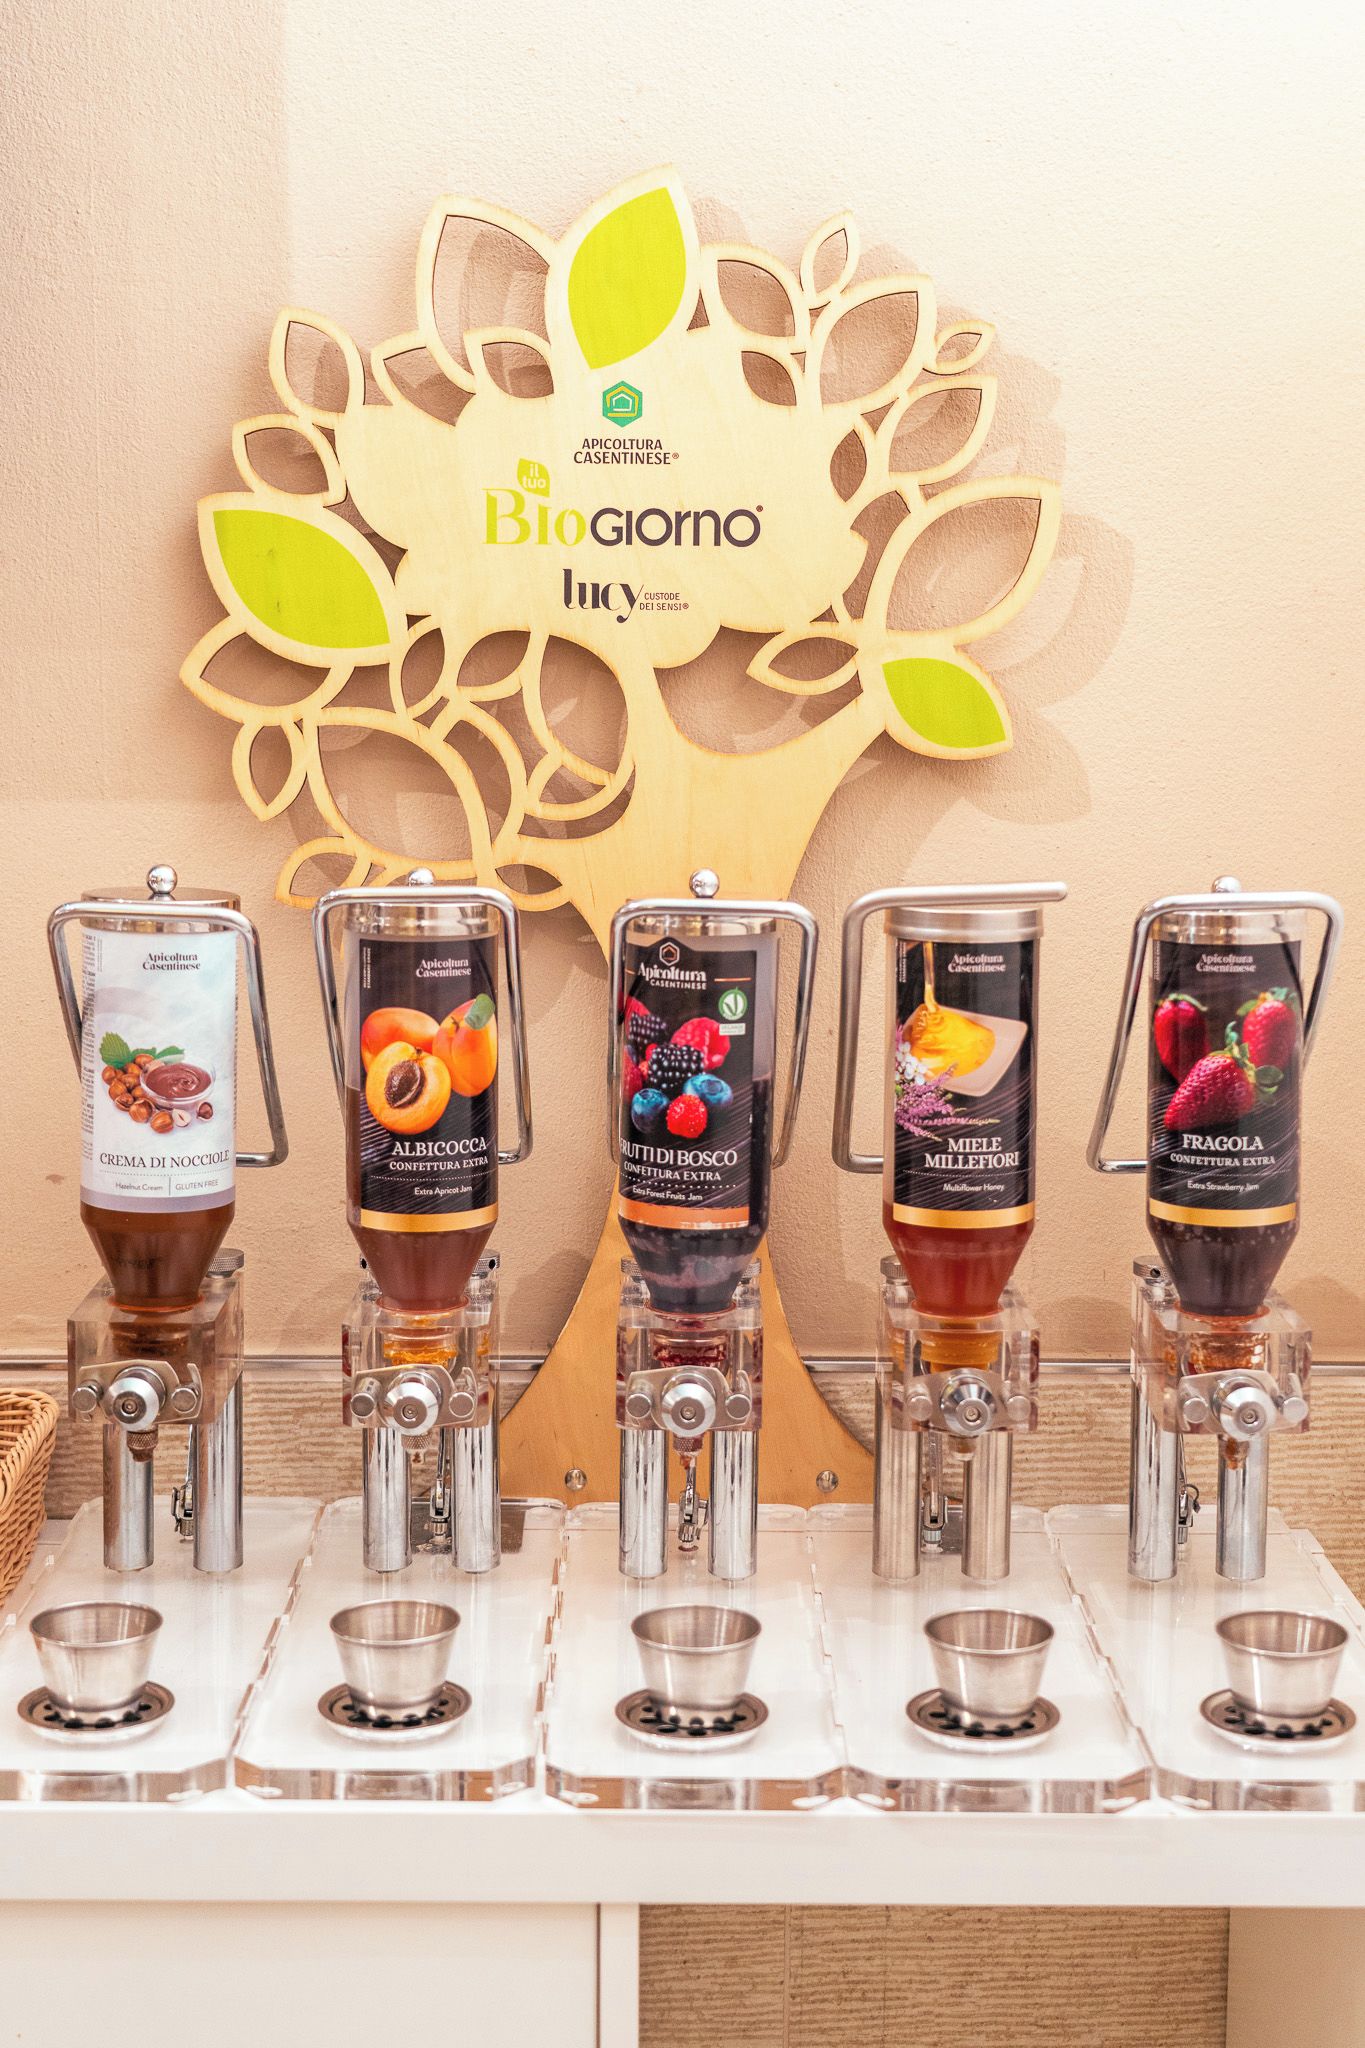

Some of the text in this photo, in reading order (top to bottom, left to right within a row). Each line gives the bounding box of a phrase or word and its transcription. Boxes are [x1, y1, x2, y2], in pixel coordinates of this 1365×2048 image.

[582, 438, 663, 450] APICOLTURA
[529, 463, 539, 478] il
[522, 476, 547, 489] tuo
[562, 568, 645, 624] lucy
[644, 592, 680, 601] CUSTODE
[639, 602, 655, 611] DEI
[146, 952, 198, 963] Apicoltura
[419, 958, 469, 969] Apicoltura
[952, 953, 1003, 964] Apicoltura
[1199, 953, 1253, 964] Apicoltura
[142, 961, 201, 971] Casentinese
[415, 966, 472, 978] Casentinese
[637, 962, 707, 981] Apicoltura
[947, 962, 1006, 973] Casentinese
[1195, 961, 1257, 973] Casentinese
[650, 980, 707, 990] CASENTINESE
[391, 1136, 487, 1156] ALBICOCCA
[947, 1137, 1002, 1153] MIELE
[1182, 1133, 1265, 1151] FRAGOLA
[99, 1149, 230, 1169] CREMA DI NOCCIOLE
[389, 1155, 488, 1171] CONFETTURA EXTRA
[656, 1148, 674, 1165] DI
[677, 1150, 738, 1167] BOSCO
[924, 1151, 1019, 1169] MILLEFIORI
[1170, 1153, 1276, 1167] CONFETTURA EXTRA
[624, 1160, 721, 1181] CONFETTURA EXTRA
[115, 1181, 163, 1191] Hazelnut Cream
[175, 1178, 219, 1191] GLUTEN FREE
[414, 1184, 472, 1197] Extra Apricot Jam
[943, 1183, 1005, 1193] Multiflower Honey
[1187, 1180, 1259, 1192] Extra Strawberry Jam
[632, 1185, 703, 1201] Extra Forest Fruits Jam
